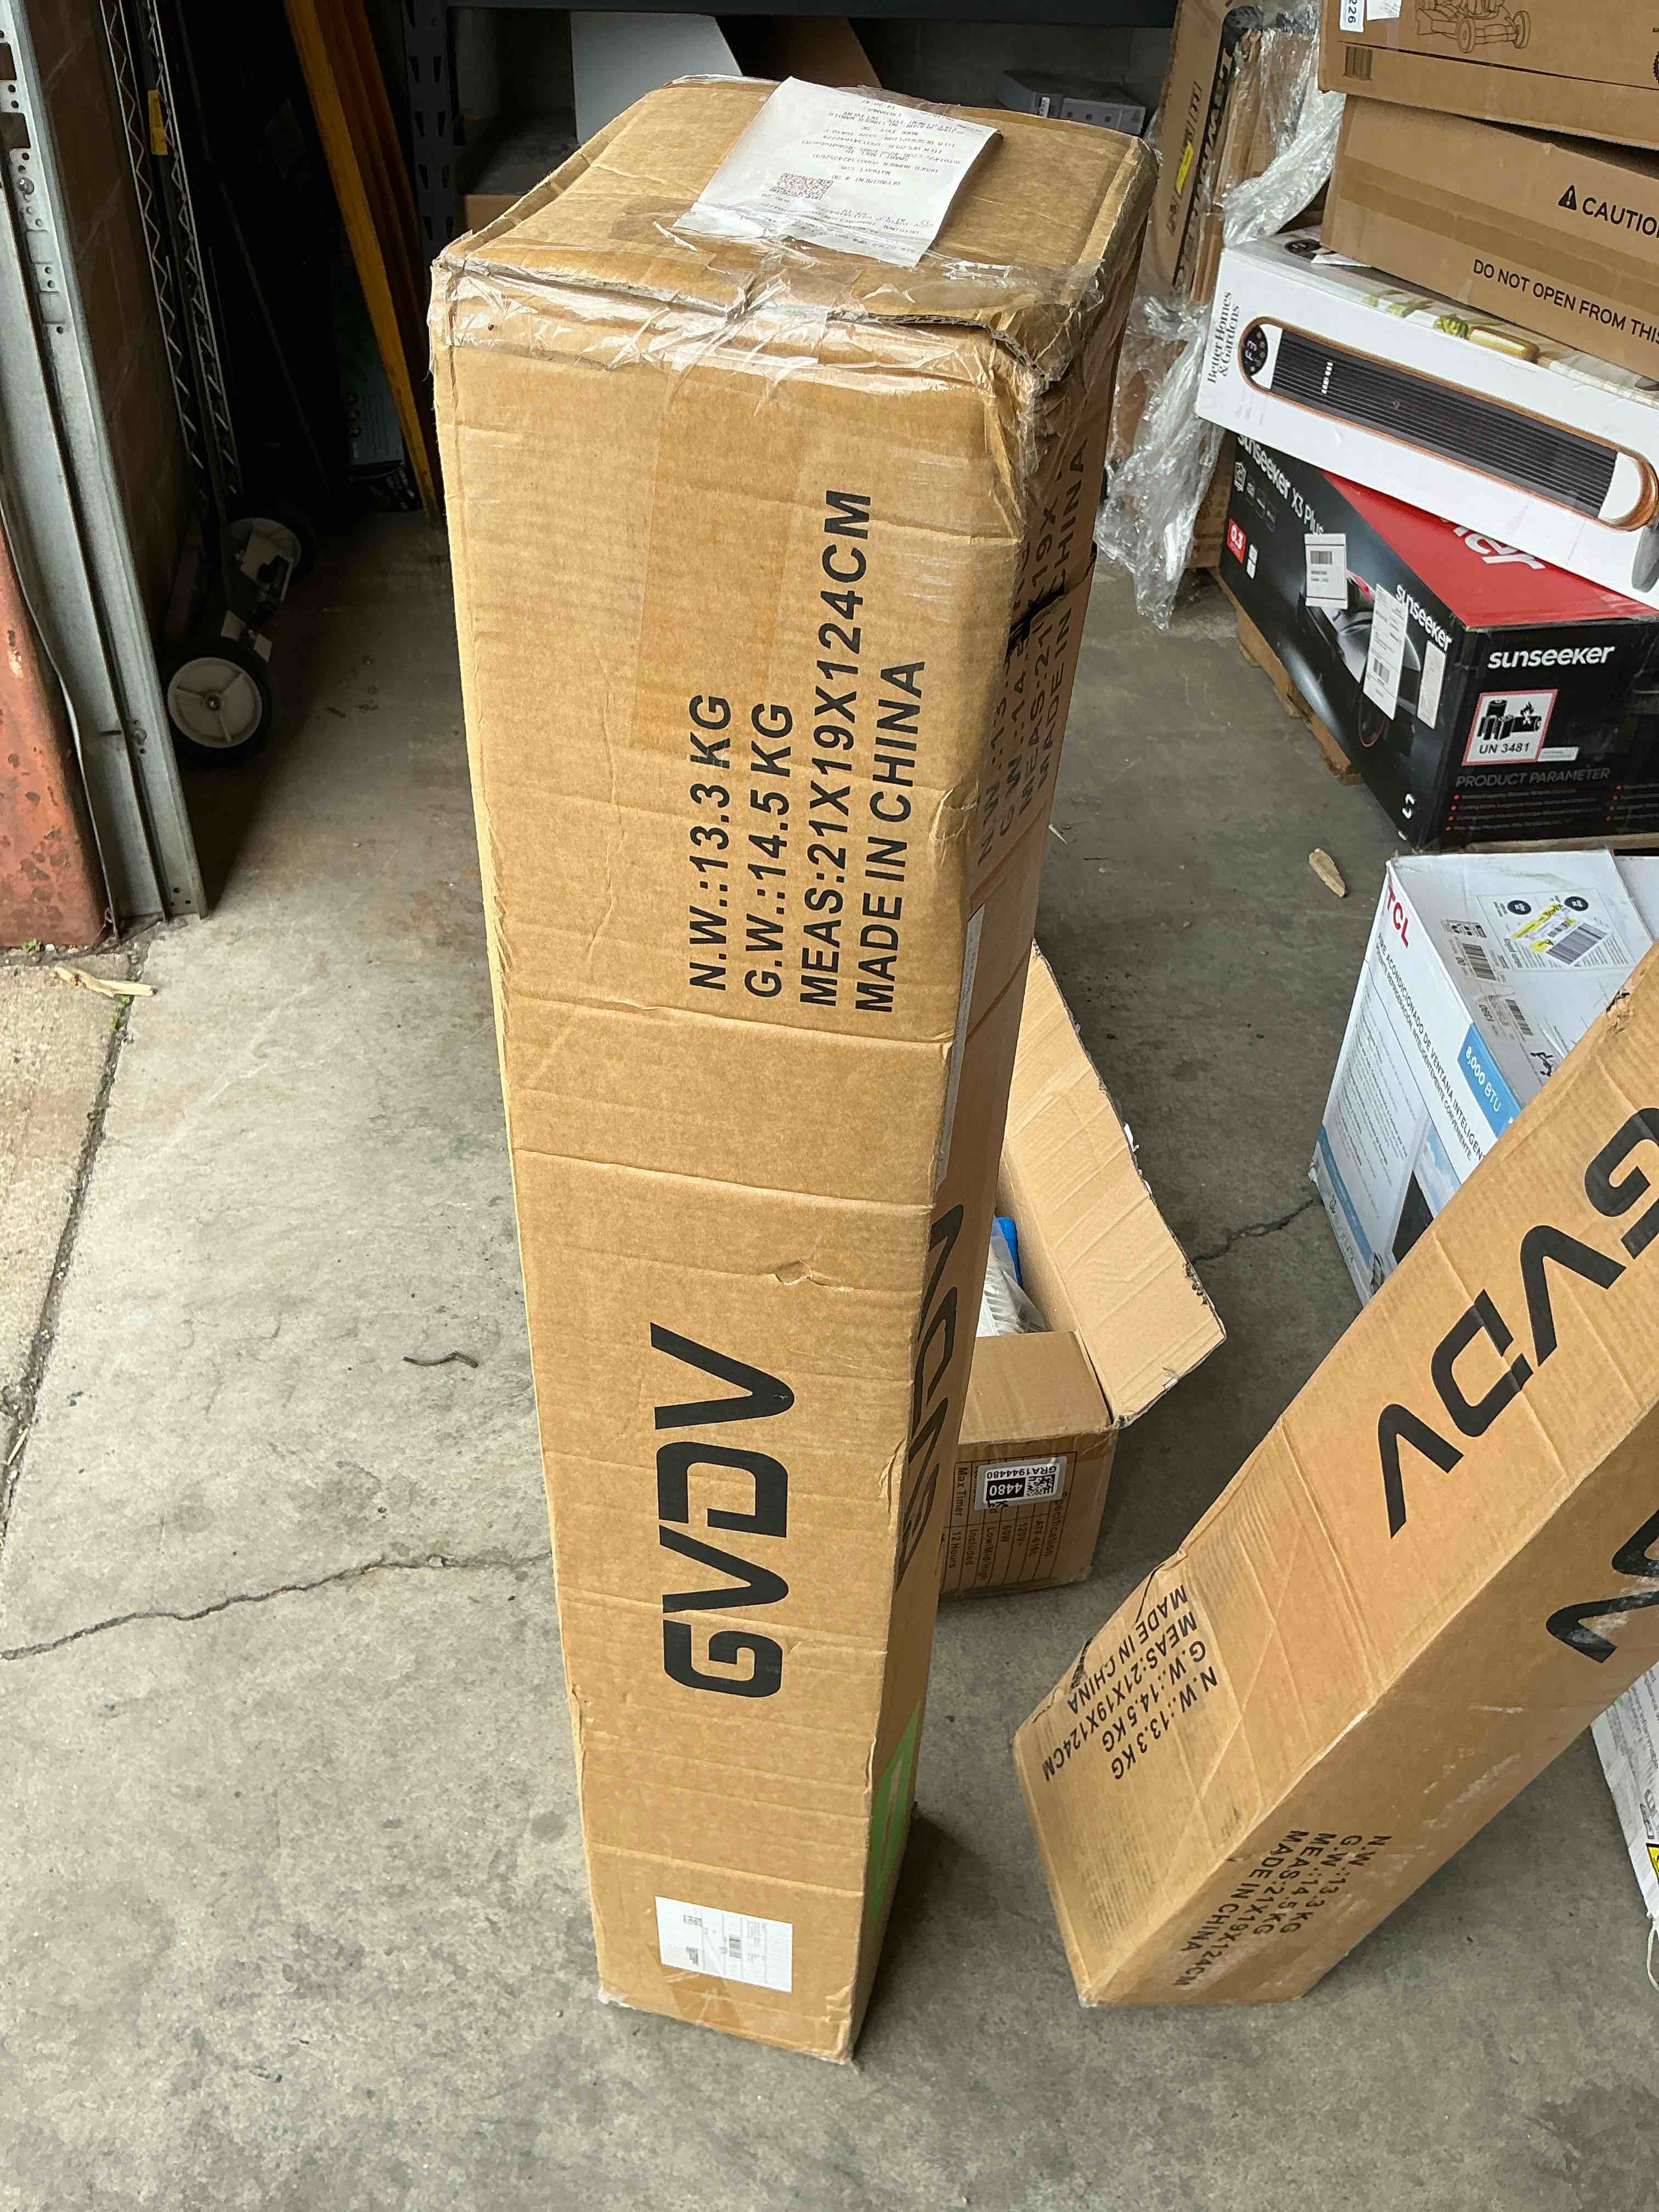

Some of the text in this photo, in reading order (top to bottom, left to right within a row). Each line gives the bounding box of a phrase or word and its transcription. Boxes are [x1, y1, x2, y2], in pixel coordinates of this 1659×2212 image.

[1474, 258, 1494, 278] DO
[1498, 269, 1531, 291] NOT
[1533, 283, 1576, 311] OPEN
[1579, 300, 1626, 331] FROM
[1207, 291, 1232, 383] Better Homes
[1221, 305, 1240, 365] Gardens
[1396, 584, 1453, 652] sunseeker
[1487, 645, 1616, 670] sunseeker
[800, 489, 872, 1007] MEAS:21X19X124CM
[1039, 662, 1064, 791] MADE
[1479, 743, 1498, 755] UN
[1501, 742, 1531, 754] 3481
[1455, 768, 1611, 788] PRODUCT PARAMETER
[690, 694, 731, 991] N.W.:13.3 KG
[744, 703, 793, 998] G.W.:14.5 KG
[855, 661, 926, 1014] MADE IN CHINA
[1387, 887, 1409, 949] TCL
[1386, 955, 1424, 1034] ACONDICIONADO
[1423, 1033, 1431, 1049] DE
[1431, 1048, 1454, 1102] VENTANA
[1465, 1046, 1502, 1113] 8,000 BTU
[955, 1467, 968, 1517] Max Timer
[987, 1465, 1057, 1480] GRA1944480
[989, 1483, 1024, 1497] 4480
[650, 1322, 795, 1699] GVDV
[949, 1531, 961, 1569] 12 Hours
[966, 1529, 979, 1566] Included
[1067, 1584, 1188, 1714] MADE IN CHINA
[1042, 1611, 1198, 1781] MEAS:21X19X124CM
[1102, 1640, 1206, 1752] G.W.:14.5 KG
[1111, 1666, 1218, 1780] N.W.:13.3 KG
[1172, 1832, 1338, 1985] MEAS:21X19X124CM
[1180, 1830, 1310, 1951] MADE IN CHINA
[1253, 1912, 1286, 1934] KG
[1280, 1911, 1313, 1933] KG
